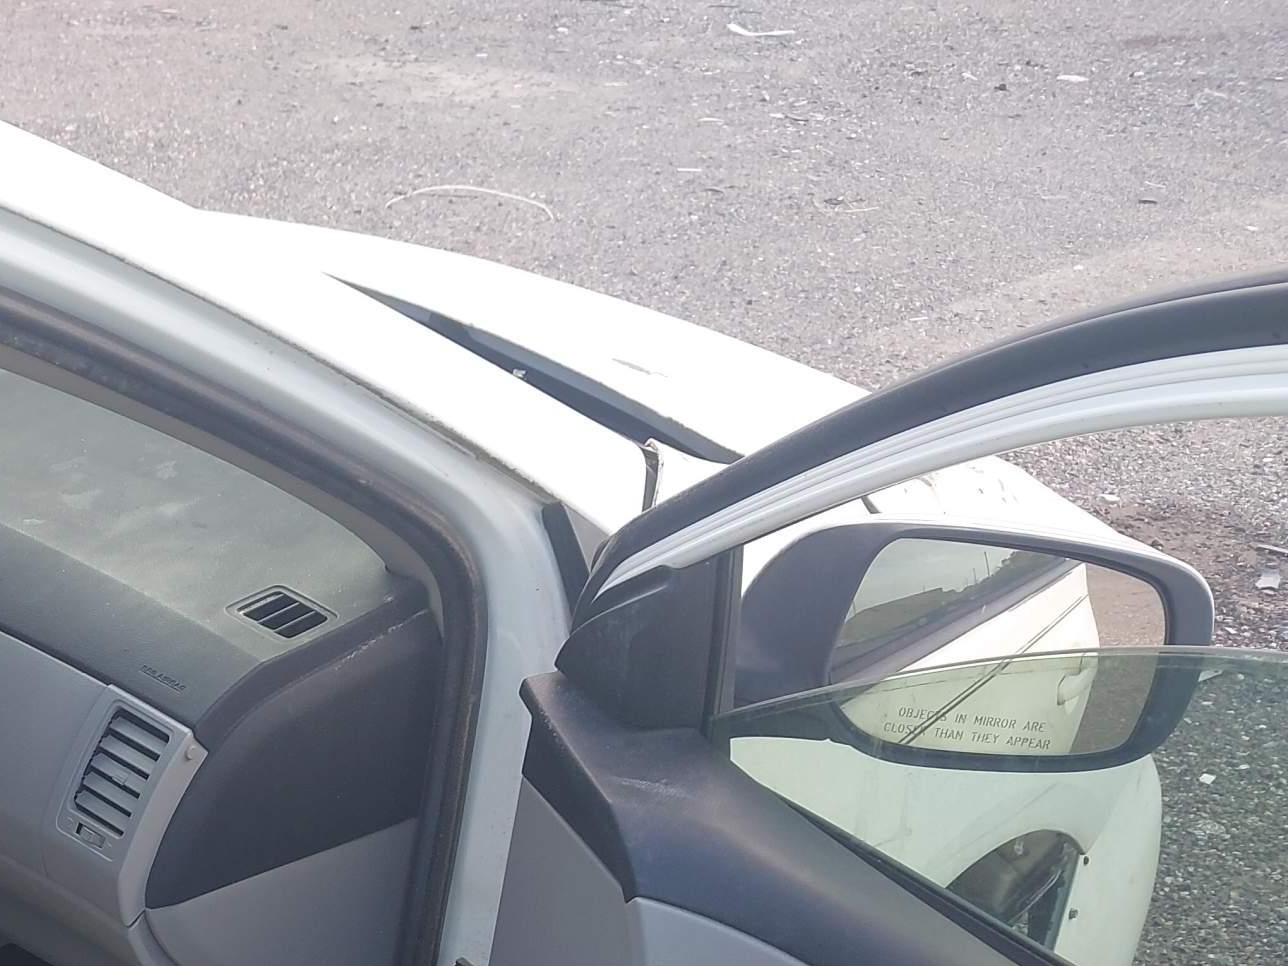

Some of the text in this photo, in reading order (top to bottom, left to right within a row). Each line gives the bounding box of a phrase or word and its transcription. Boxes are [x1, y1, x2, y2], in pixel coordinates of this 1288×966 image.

[955, 713, 967, 724] IN
[974, 715, 1016, 729] MIRROR
[1023, 720, 1048, 732] ARE
[935, 728, 964, 741] THAN
[972, 732, 1000, 744] THEY
[1006, 736, 1051, 750] APPEAR
